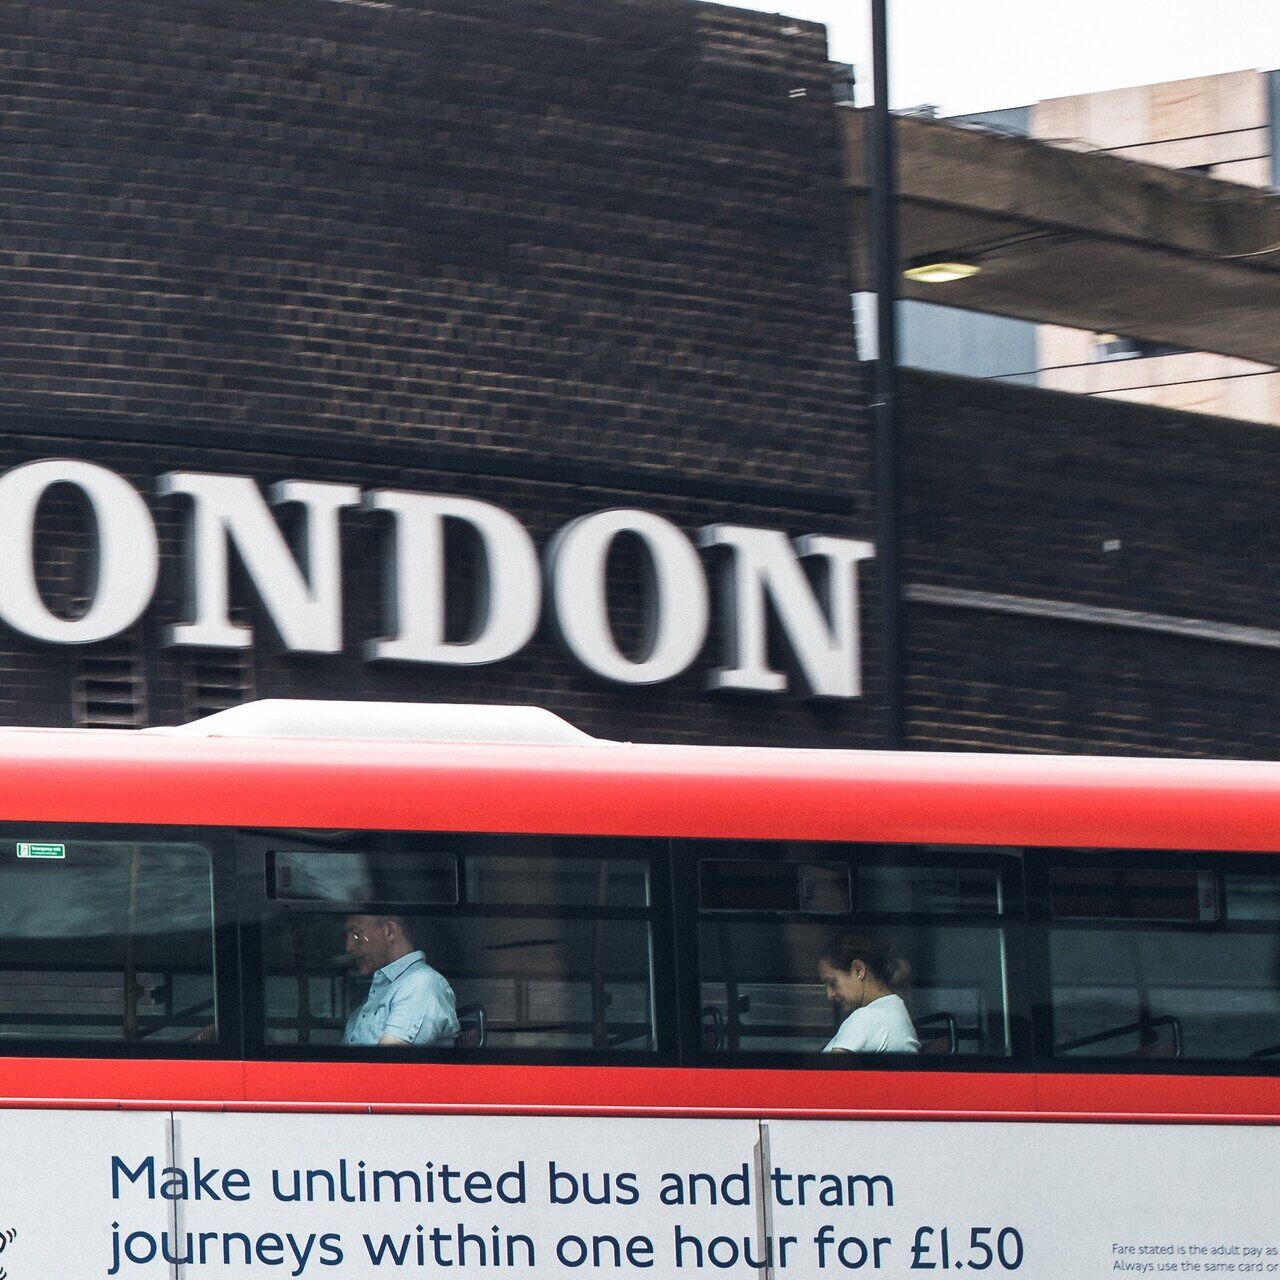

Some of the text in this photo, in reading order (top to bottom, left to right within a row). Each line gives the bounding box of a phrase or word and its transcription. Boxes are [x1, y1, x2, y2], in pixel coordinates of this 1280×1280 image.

[111, 1155, 895, 1207] Make unlimited bus and tram
[107, 1221, 1025, 1277] journeys within one hour for £1.50
[1112, 1243, 1279, 1258] Fare stated is the adult pay as
[1112, 1260, 1155, 1274] Always
[1157, 1262, 1179, 1272] use
[1181, 1261, 1201, 1272] the
[1204, 1262, 1236, 1272] same
[1238, 1261, 1264, 1272] card
